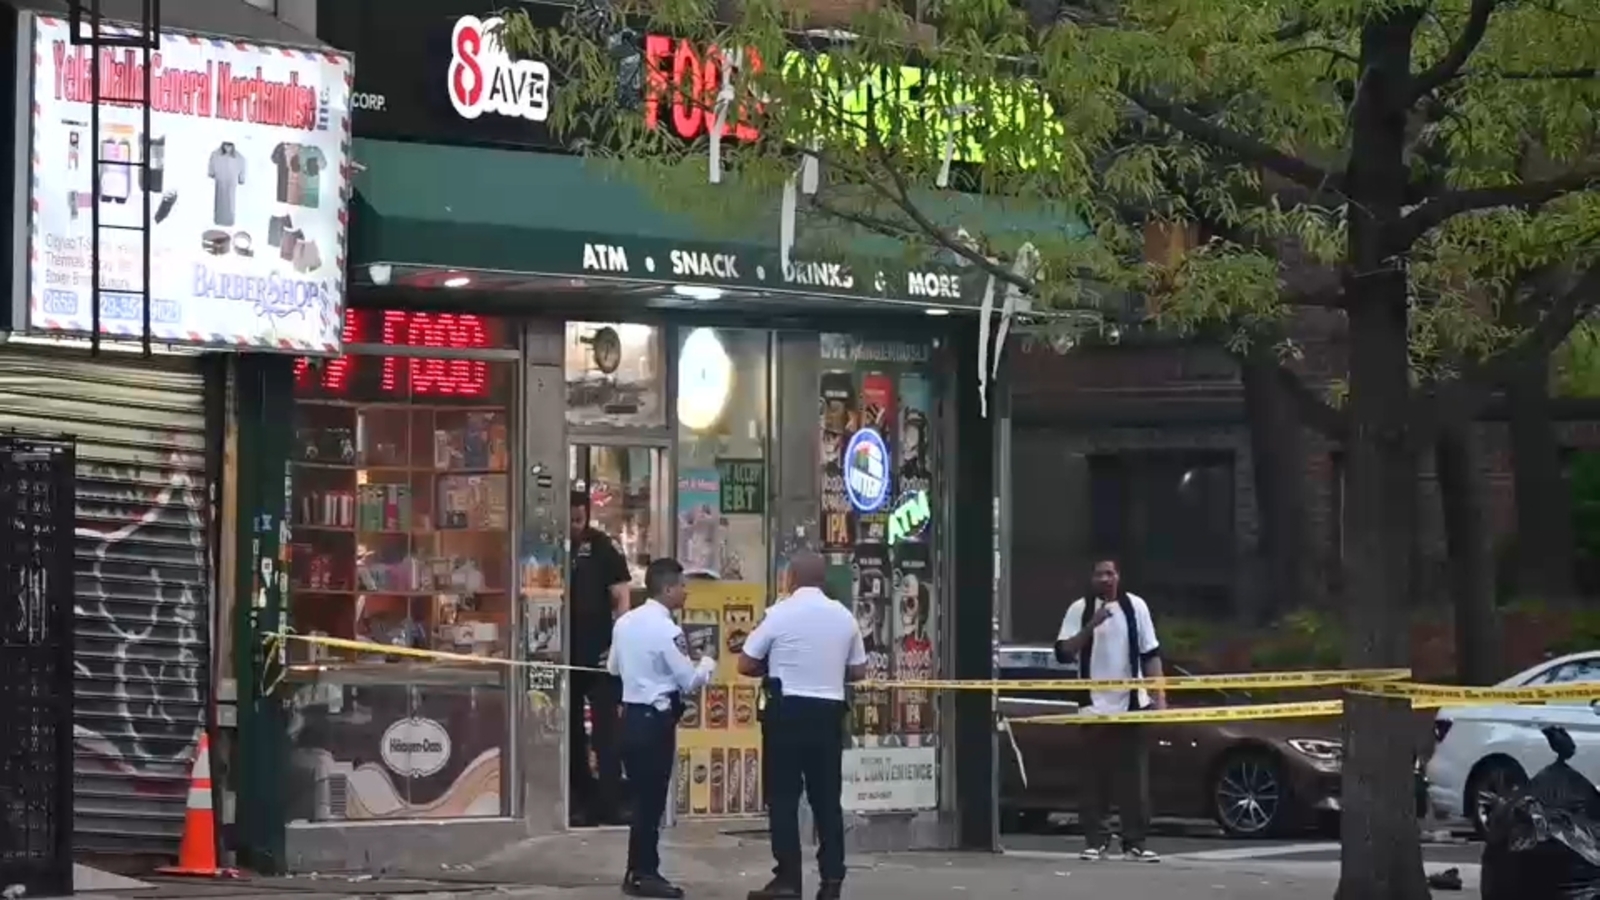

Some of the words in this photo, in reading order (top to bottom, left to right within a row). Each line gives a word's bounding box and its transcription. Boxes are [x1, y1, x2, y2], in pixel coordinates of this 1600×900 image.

[151, 52, 213, 118] General
[216, 60, 318, 131] Merchandise
[351, 91, 387, 111] CORP.
[582, 243, 630, 273] ATM
[671, 250, 740, 279] SNACK
[908, 271, 961, 298] MORE
[722, 485, 757, 512] EBT
[887, 490, 931, 546] ATM
[826, 512, 849, 543] IPA
